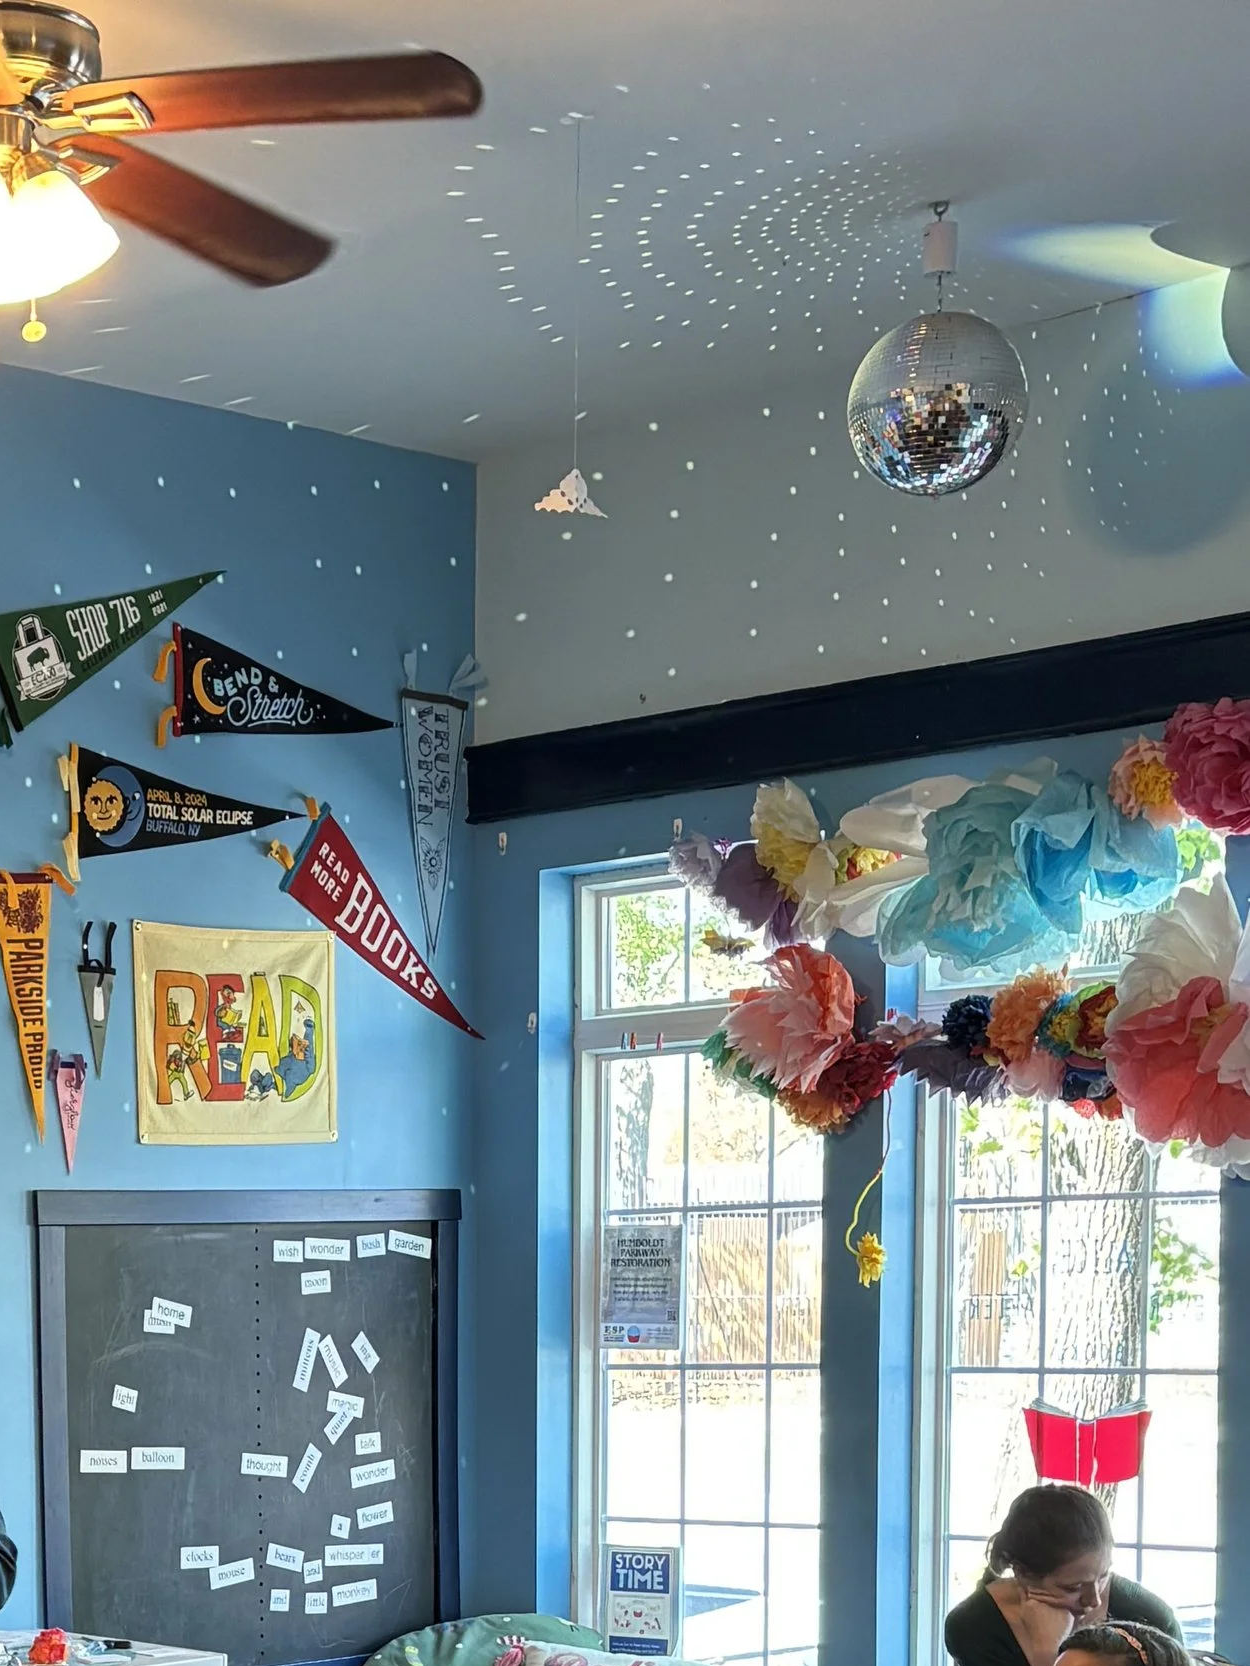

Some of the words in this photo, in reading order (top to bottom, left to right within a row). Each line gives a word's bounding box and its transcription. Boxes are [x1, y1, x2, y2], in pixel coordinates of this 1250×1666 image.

[147, 589, 163, 604] 1821
[152, 603, 168, 616] 2021
[65, 603, 111, 661] SHOP
[108, 595, 141, 634] 716
[213, 667, 263, 697] BEND
[268, 676, 279, 693] &
[227, 686, 313, 726] Stretch
[417, 705, 434, 826] WOMEN
[433, 708, 450, 816] TRUST
[147, 788, 173, 803] APRIL
[184, 792, 208, 807] 2024
[147, 803, 179, 820] TOTAL
[181, 808, 214, 824] SOLAR
[216, 809, 254, 825] ECLIPSE
[188, 824, 201, 837] NY
[318, 842, 350, 885] READ
[310, 860, 342, 902] MORE
[334, 872, 438, 1000] BOOKS
[6, 938, 44, 1028] PARKSIDE
[155, 970, 323, 1105] READ
[24, 1031, 44, 1090] PROUD
[278, 1246, 299, 1257] wish
[310, 1243, 344, 1255] wonder
[394, 1238, 425, 1253] garden
[617, 1239, 664, 1248] HUMBOLDT
[620, 1248, 661, 1257] PARKWAY
[610, 1258, 671, 1267] RESTORATION
[157, 1302, 186, 1321] home
[299, 1339, 315, 1381] mittens
[324, 1344, 342, 1379] music
[115, 1389, 135, 1406] light
[360, 1438, 376, 1450] talk
[141, 1452, 175, 1464] balloon
[246, 1458, 282, 1474] thought
[299, 1453, 315, 1483] comb
[355, 1466, 390, 1482] wonder
[186, 1552, 214, 1563] clocks
[329, 1550, 365, 1562] whisper
[615, 1553, 666, 1570] STORY
[218, 1567, 246, 1580] mouse
[615, 1569, 664, 1590] TIME
[336, 1587, 372, 1600] monkey
